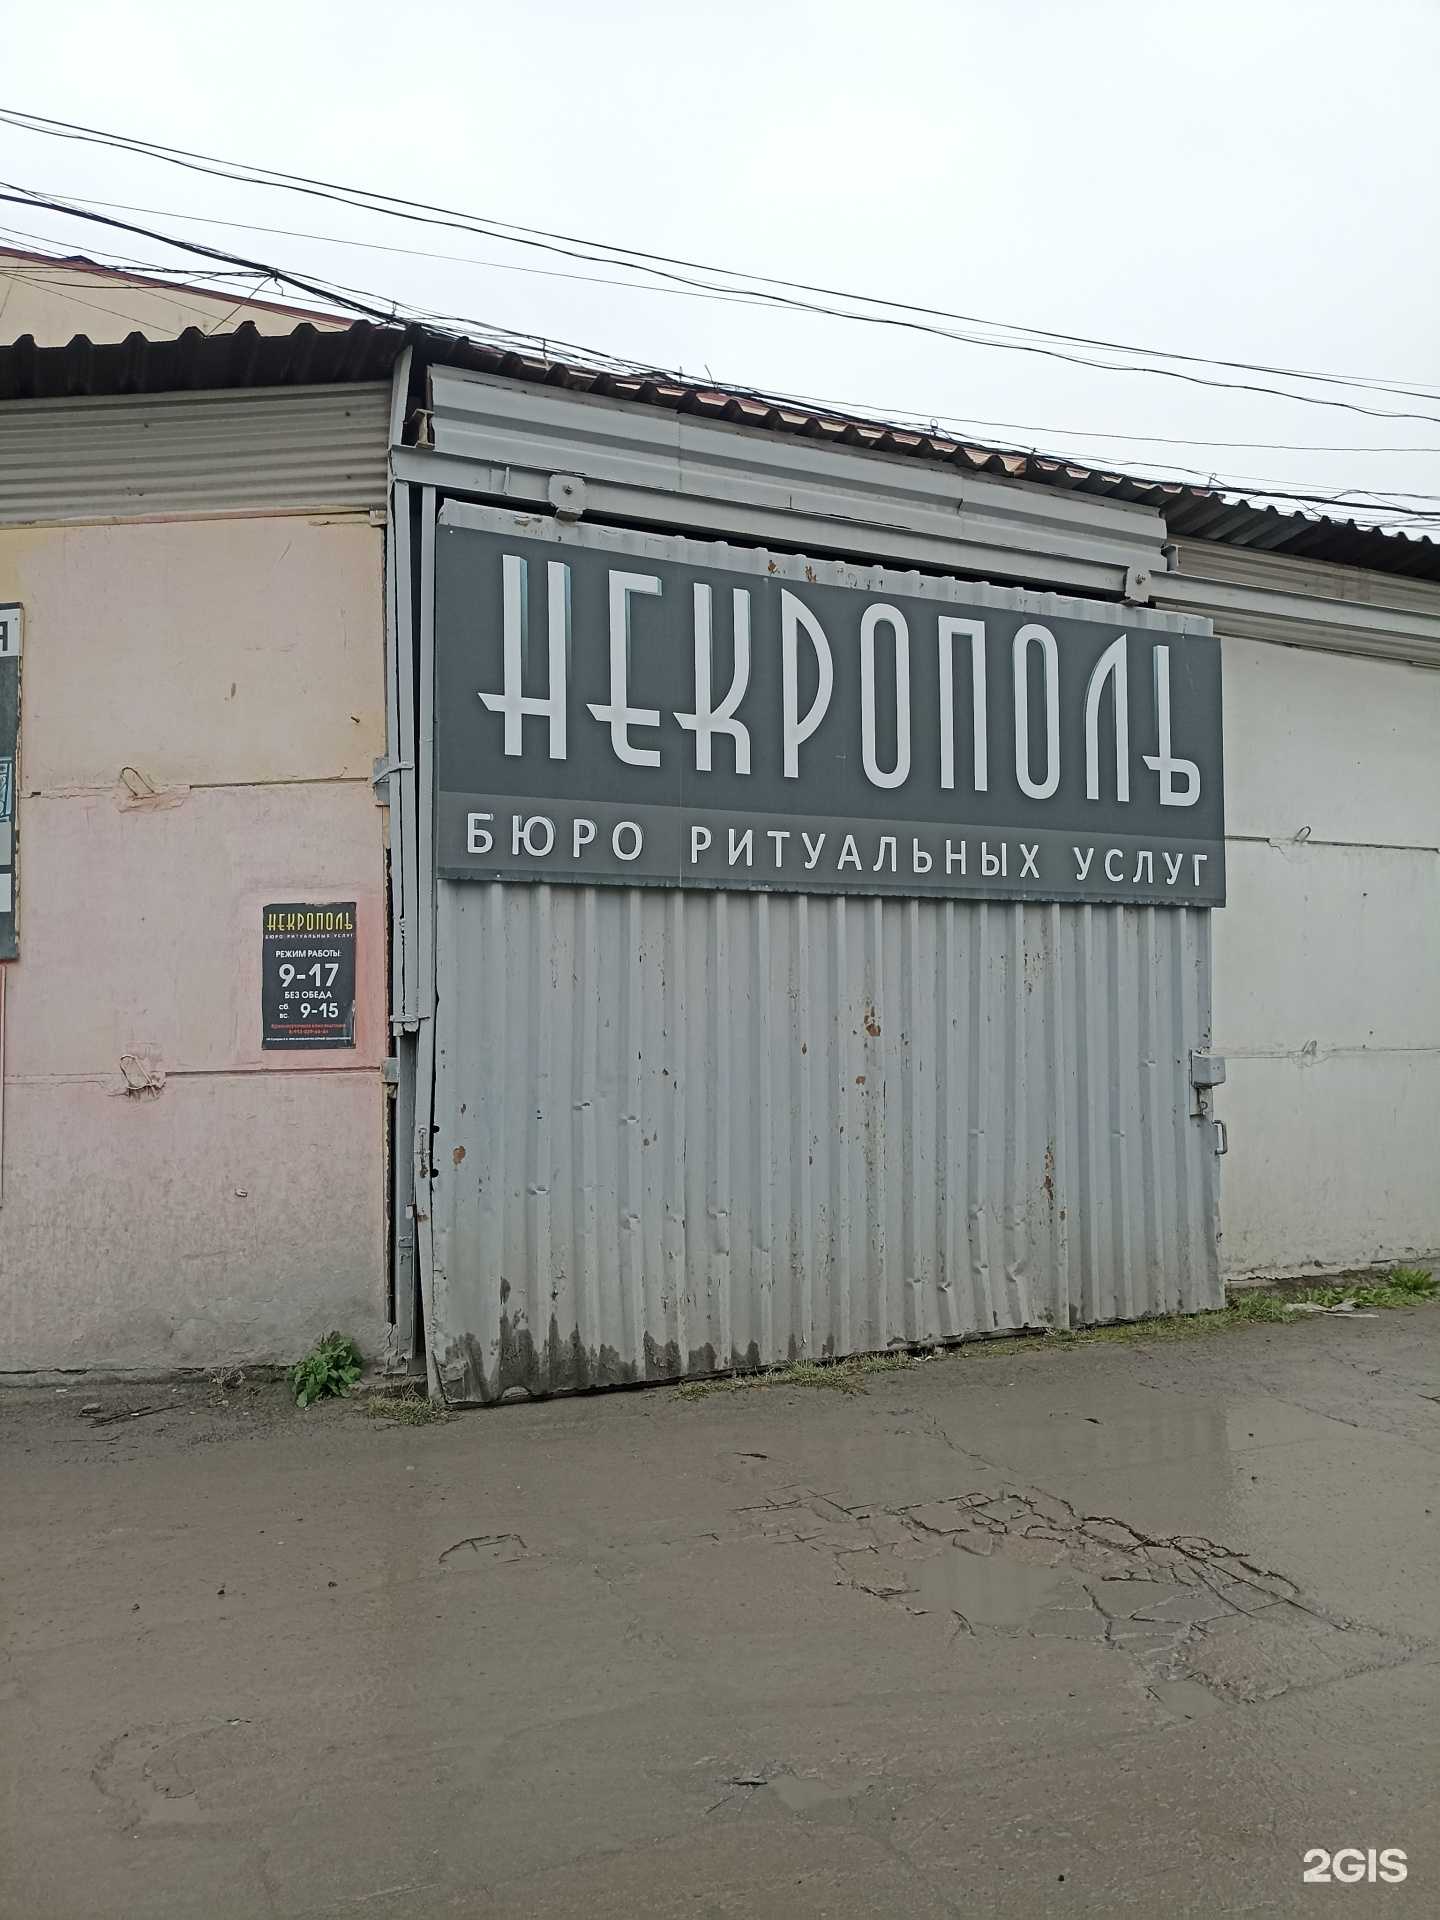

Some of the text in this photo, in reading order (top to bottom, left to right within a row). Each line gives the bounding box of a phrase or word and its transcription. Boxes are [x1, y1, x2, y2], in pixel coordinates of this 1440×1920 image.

[477, 553, 1202, 808] НЕКРОПОЛЬ
[466, 811, 1210, 888] БЮРО РИТУАЛЬНЫХ УСЛУГ
[267, 912, 353, 931] НЕКРОПОЛЬ
[275, 949, 307, 958] РЕЖИМ
[279, 963, 339, 987] 9-17
[284, 991, 332, 999] БЕЗ ОБЕДА
[300, 1003, 339, 1018] 9-15
